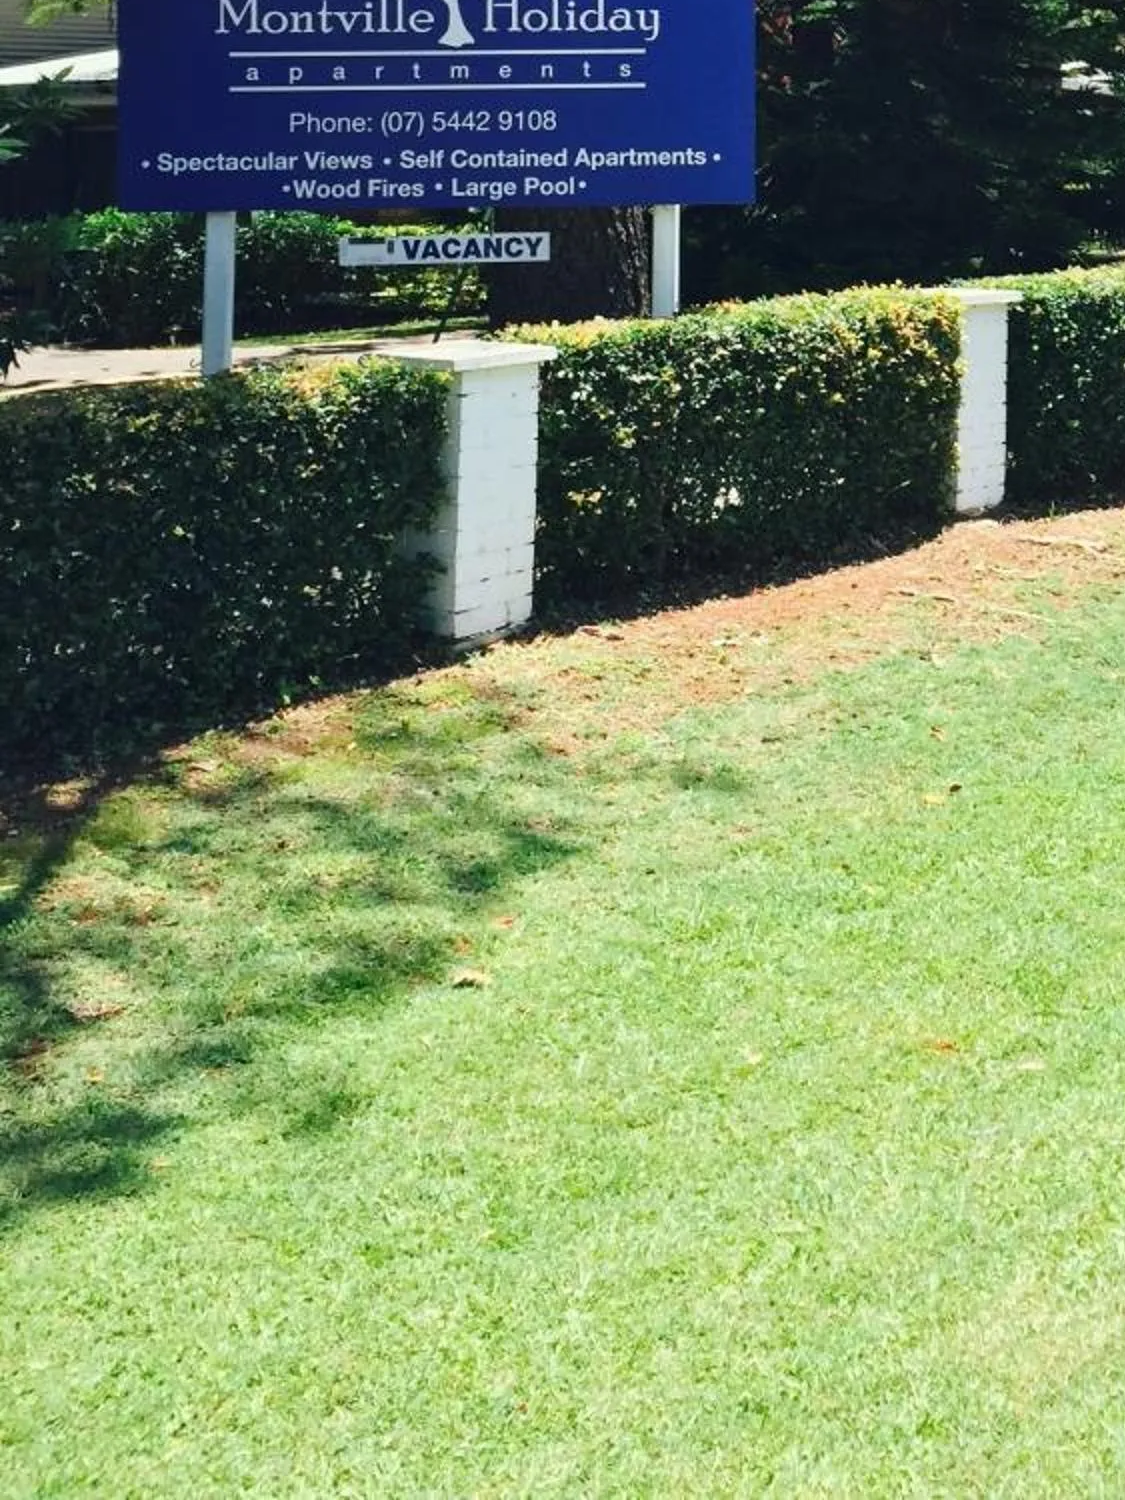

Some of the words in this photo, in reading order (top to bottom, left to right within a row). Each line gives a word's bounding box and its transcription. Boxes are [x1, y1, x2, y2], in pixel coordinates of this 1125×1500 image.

[245, 62, 632, 83] apartments
[289, 112, 373, 133] Phone:
[381, 111, 425, 137] (07)
[432, 111, 490, 132] 5442
[499, 110, 557, 131] 9108
[157, 152, 299, 175] Spectacular
[303, 151, 373, 170] Views
[400, 149, 444, 169] Self
[450, 148, 568, 168] Contained
[574, 147, 707, 170] Apartments
[293, 179, 361, 198] Wood
[367, 178, 425, 197] Fires
[451, 177, 517, 200] Large
[524, 176, 576, 195] Pool
[402, 236, 544, 260] VACANCY
